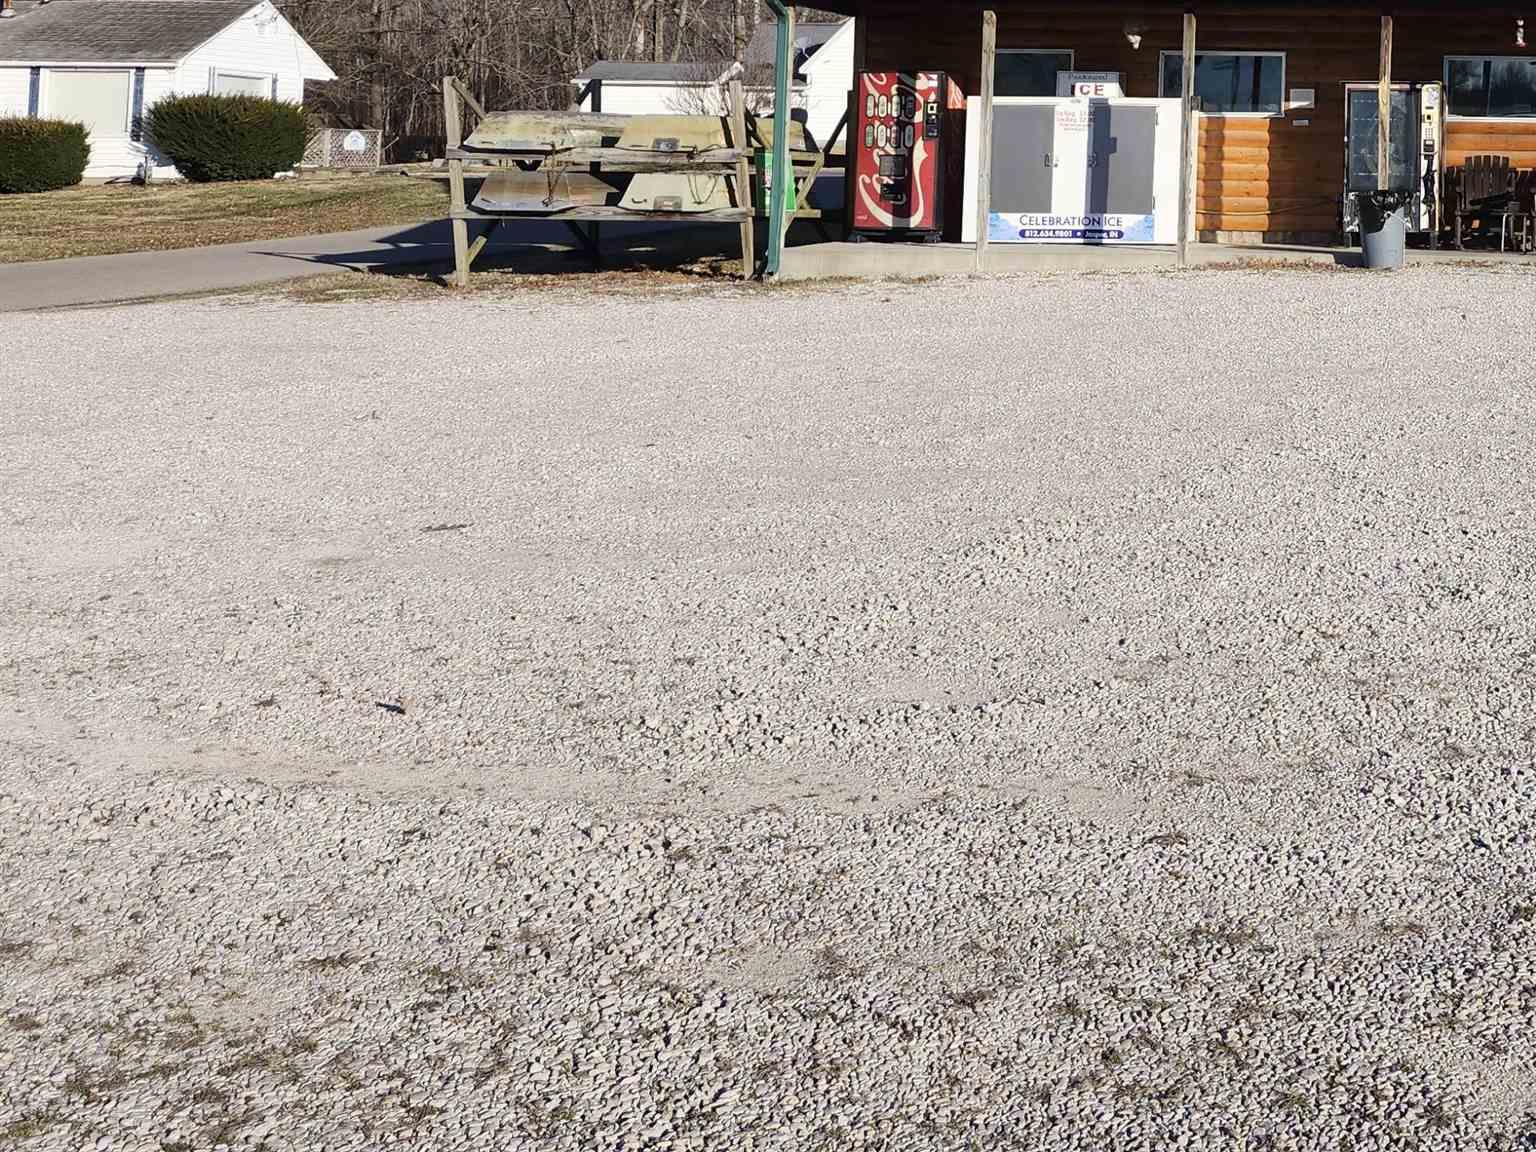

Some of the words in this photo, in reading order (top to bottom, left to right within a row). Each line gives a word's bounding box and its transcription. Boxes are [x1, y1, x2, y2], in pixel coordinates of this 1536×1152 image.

[1071, 83, 1104, 96] ICE
[1019, 214, 1101, 227] CELEBRATION
[1104, 216, 1123, 227] ICE
